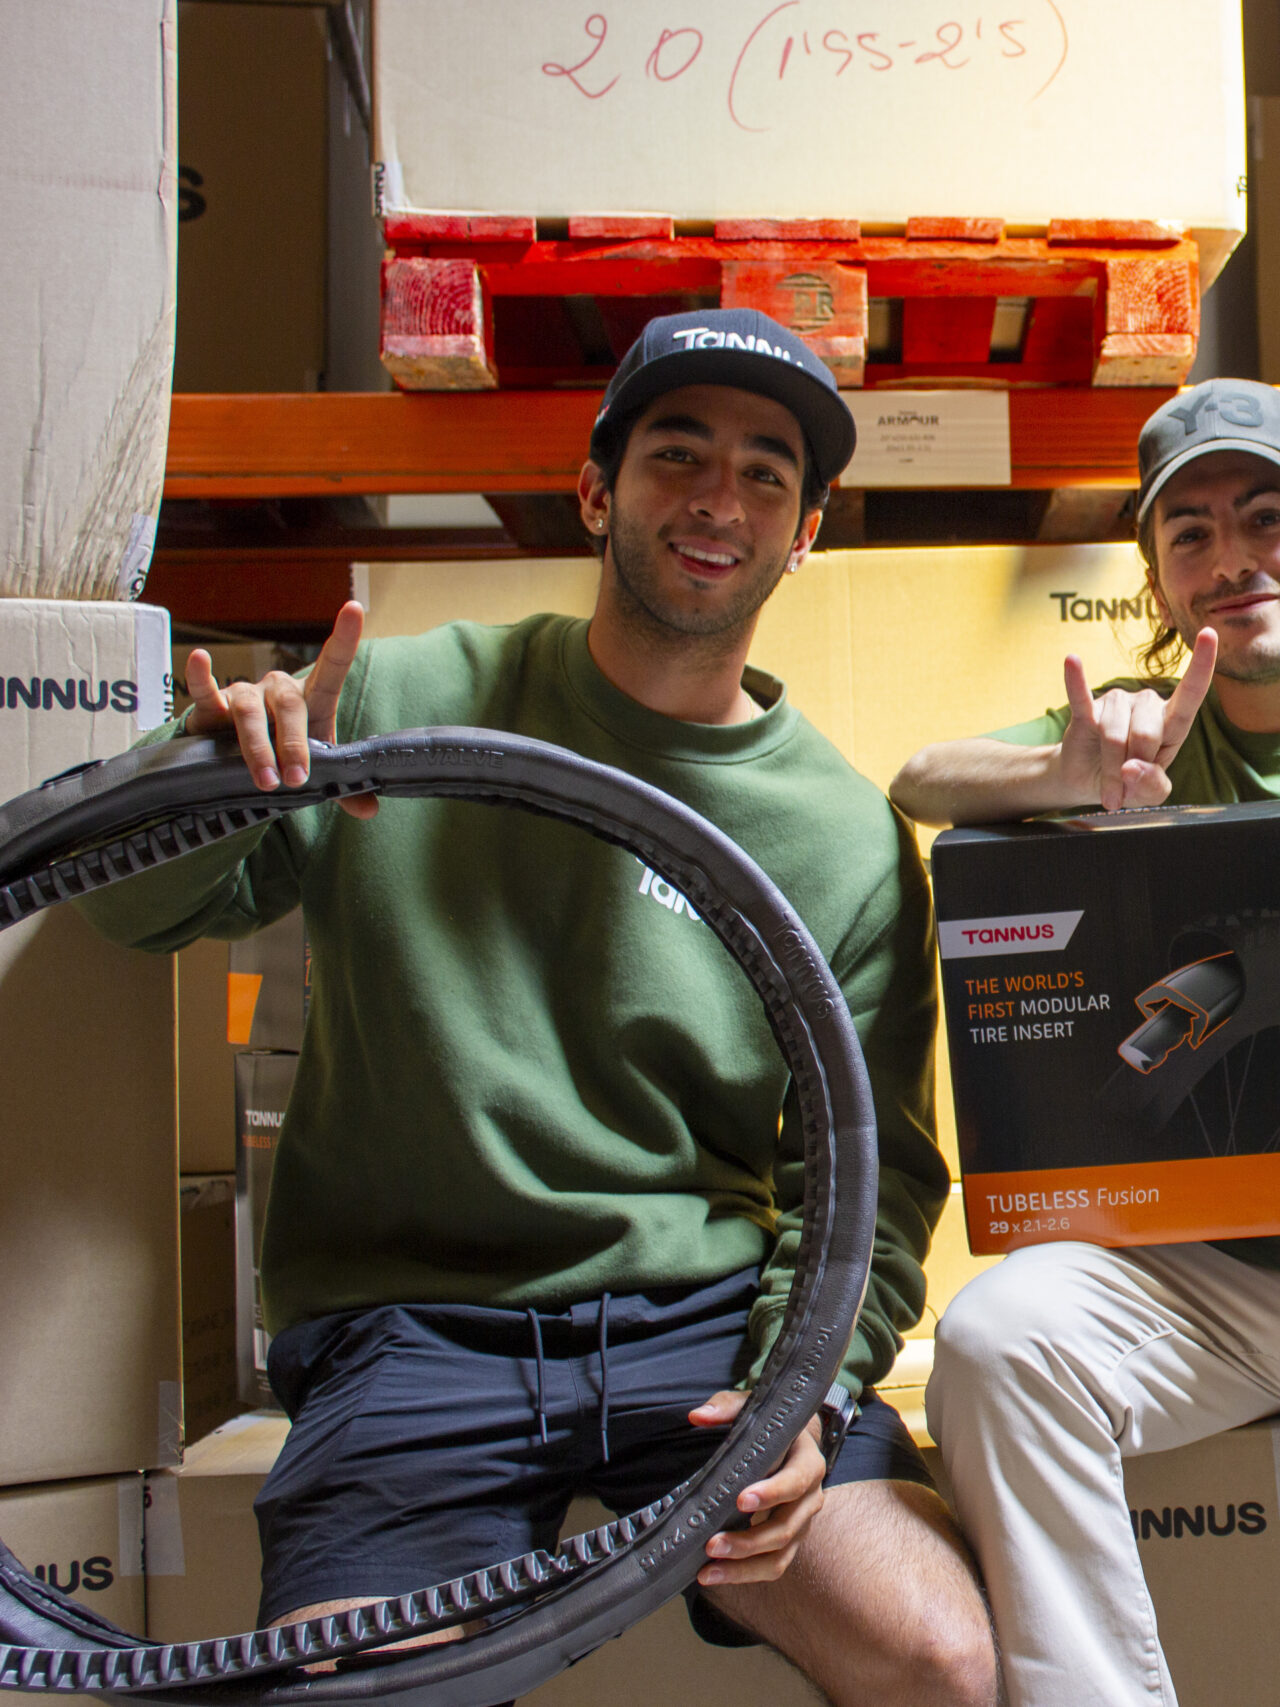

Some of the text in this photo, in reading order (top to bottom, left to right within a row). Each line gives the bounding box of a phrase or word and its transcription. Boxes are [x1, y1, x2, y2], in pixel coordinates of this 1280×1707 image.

[965, 971, 1085, 996] THE WORLD'S
[968, 994, 1111, 1020] FIRST MODULAR
[970, 1021, 1075, 1044] TIRE INSERT
[987, 1186, 1160, 1214] TUBELESS Fusion
[990, 1221, 1010, 1234] 29
[1023, 1218, 1070, 1232] 2.1-2.6
